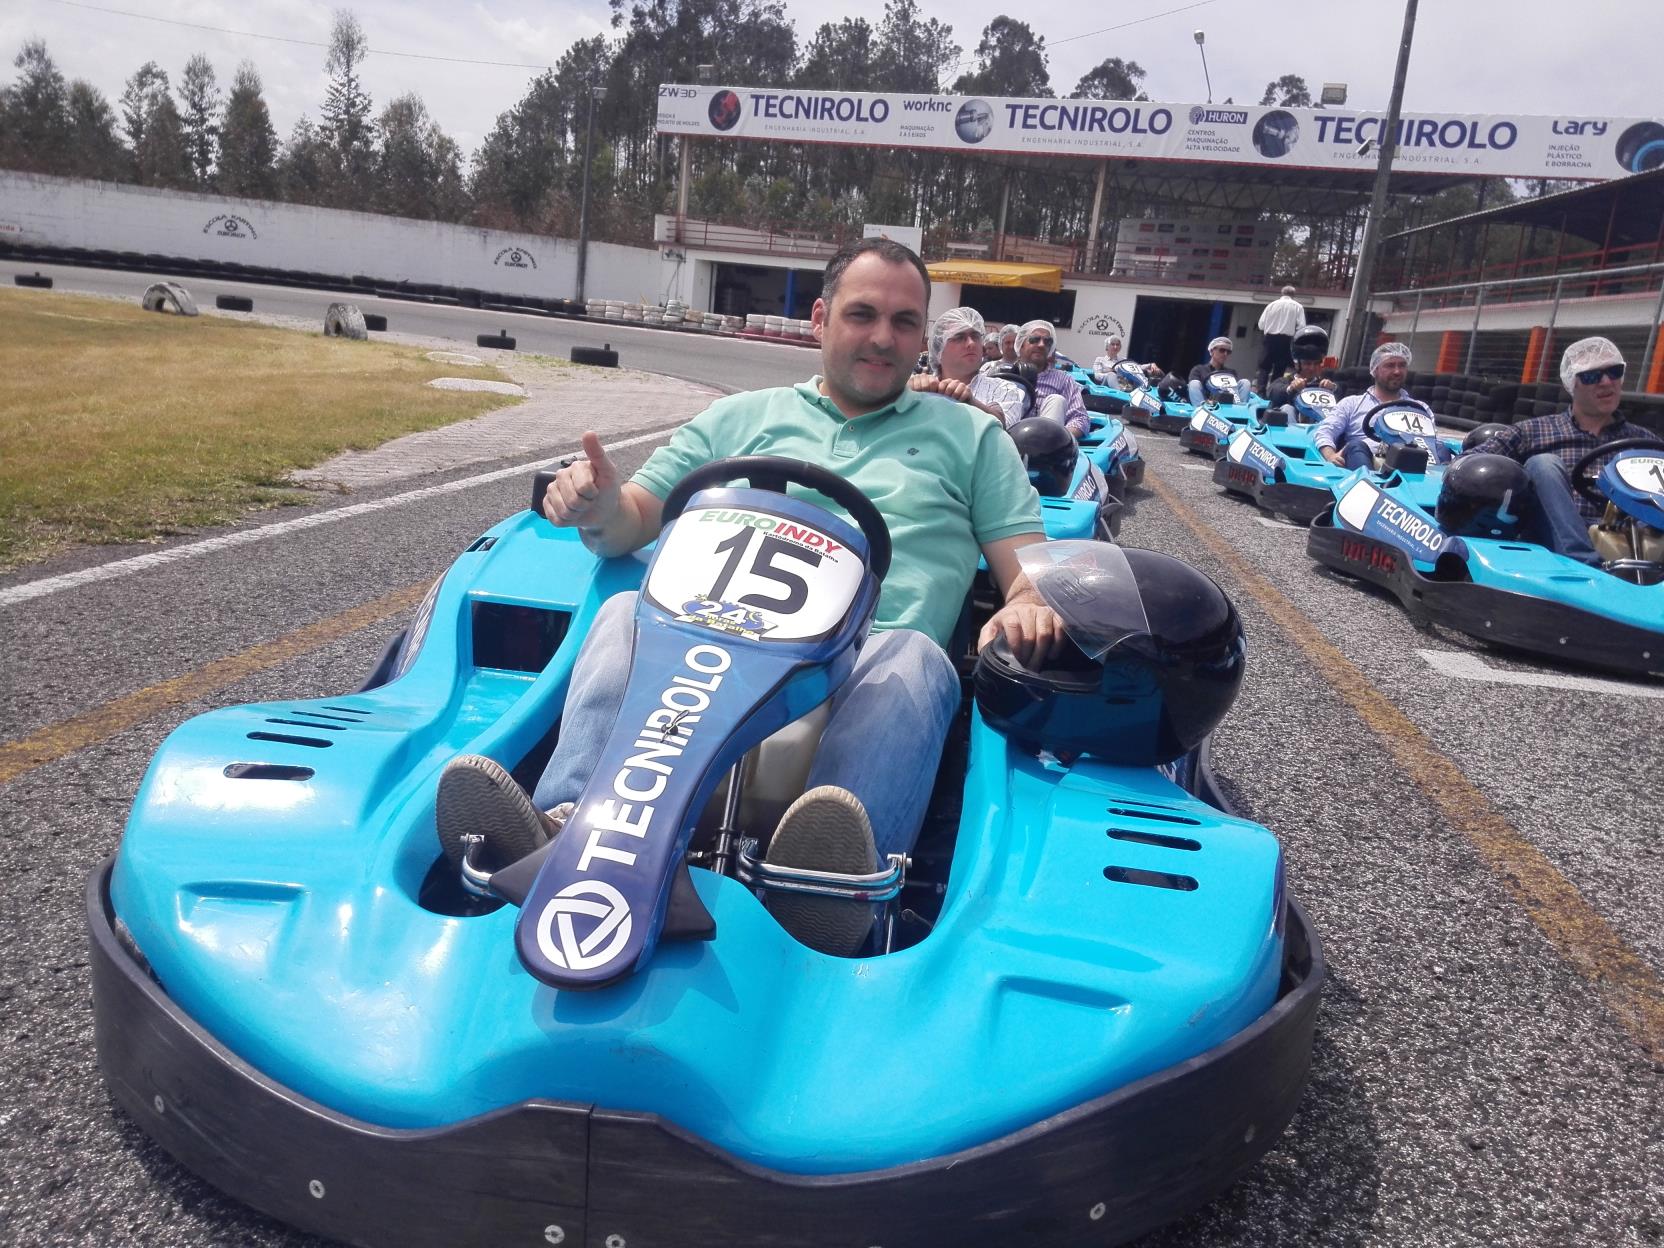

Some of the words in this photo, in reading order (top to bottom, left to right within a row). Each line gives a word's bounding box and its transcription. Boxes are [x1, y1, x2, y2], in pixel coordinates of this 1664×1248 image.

[750, 94, 889, 123] TECNIROLO
[903, 98, 952, 112] worknc
[1208, 111, 1245, 123] HURON
[1005, 104, 1172, 135] TECNIROLO
[1552, 120, 1608, 136] Lary
[1021, 136, 1071, 144] ENGENHARIA
[1548, 143, 1580, 152] INJEÇÃO
[1220, 377, 1230, 385] 5
[1309, 393, 1331, 404] 26
[1401, 414, 1424, 432] 14
[1248, 441, 1279, 469] TECNIROL
[1649, 465, 1664, 490] 1
[698, 510, 843, 554] EUROINDY
[1377, 498, 1443, 551] TECNIROLO
[706, 525, 823, 615] 15
[695, 600, 748, 625] 24
[576, 644, 732, 872] TECNIROLO
